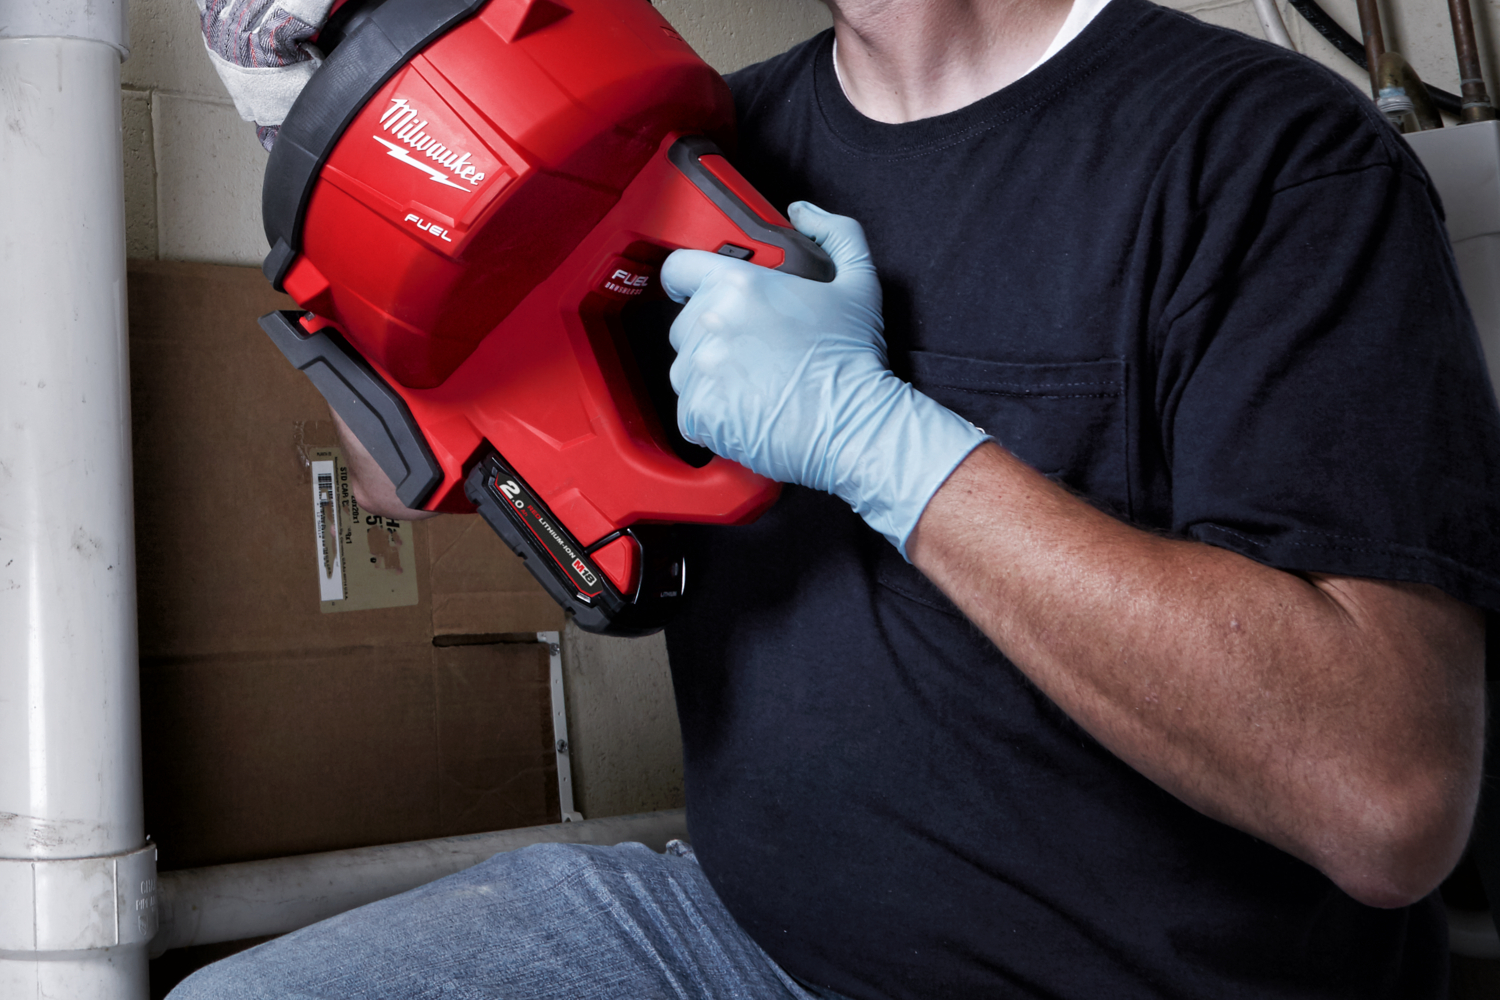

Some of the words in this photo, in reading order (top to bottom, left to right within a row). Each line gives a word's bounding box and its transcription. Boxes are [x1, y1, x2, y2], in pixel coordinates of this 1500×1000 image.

[379, 98, 485, 186] Milwaukee
[404, 213, 452, 242] FUEL
[611, 269, 649, 287] FUEL
[340, 466, 348, 481] STD
[499, 480, 525, 509] 2.0
[573, 558, 597, 586] M18
